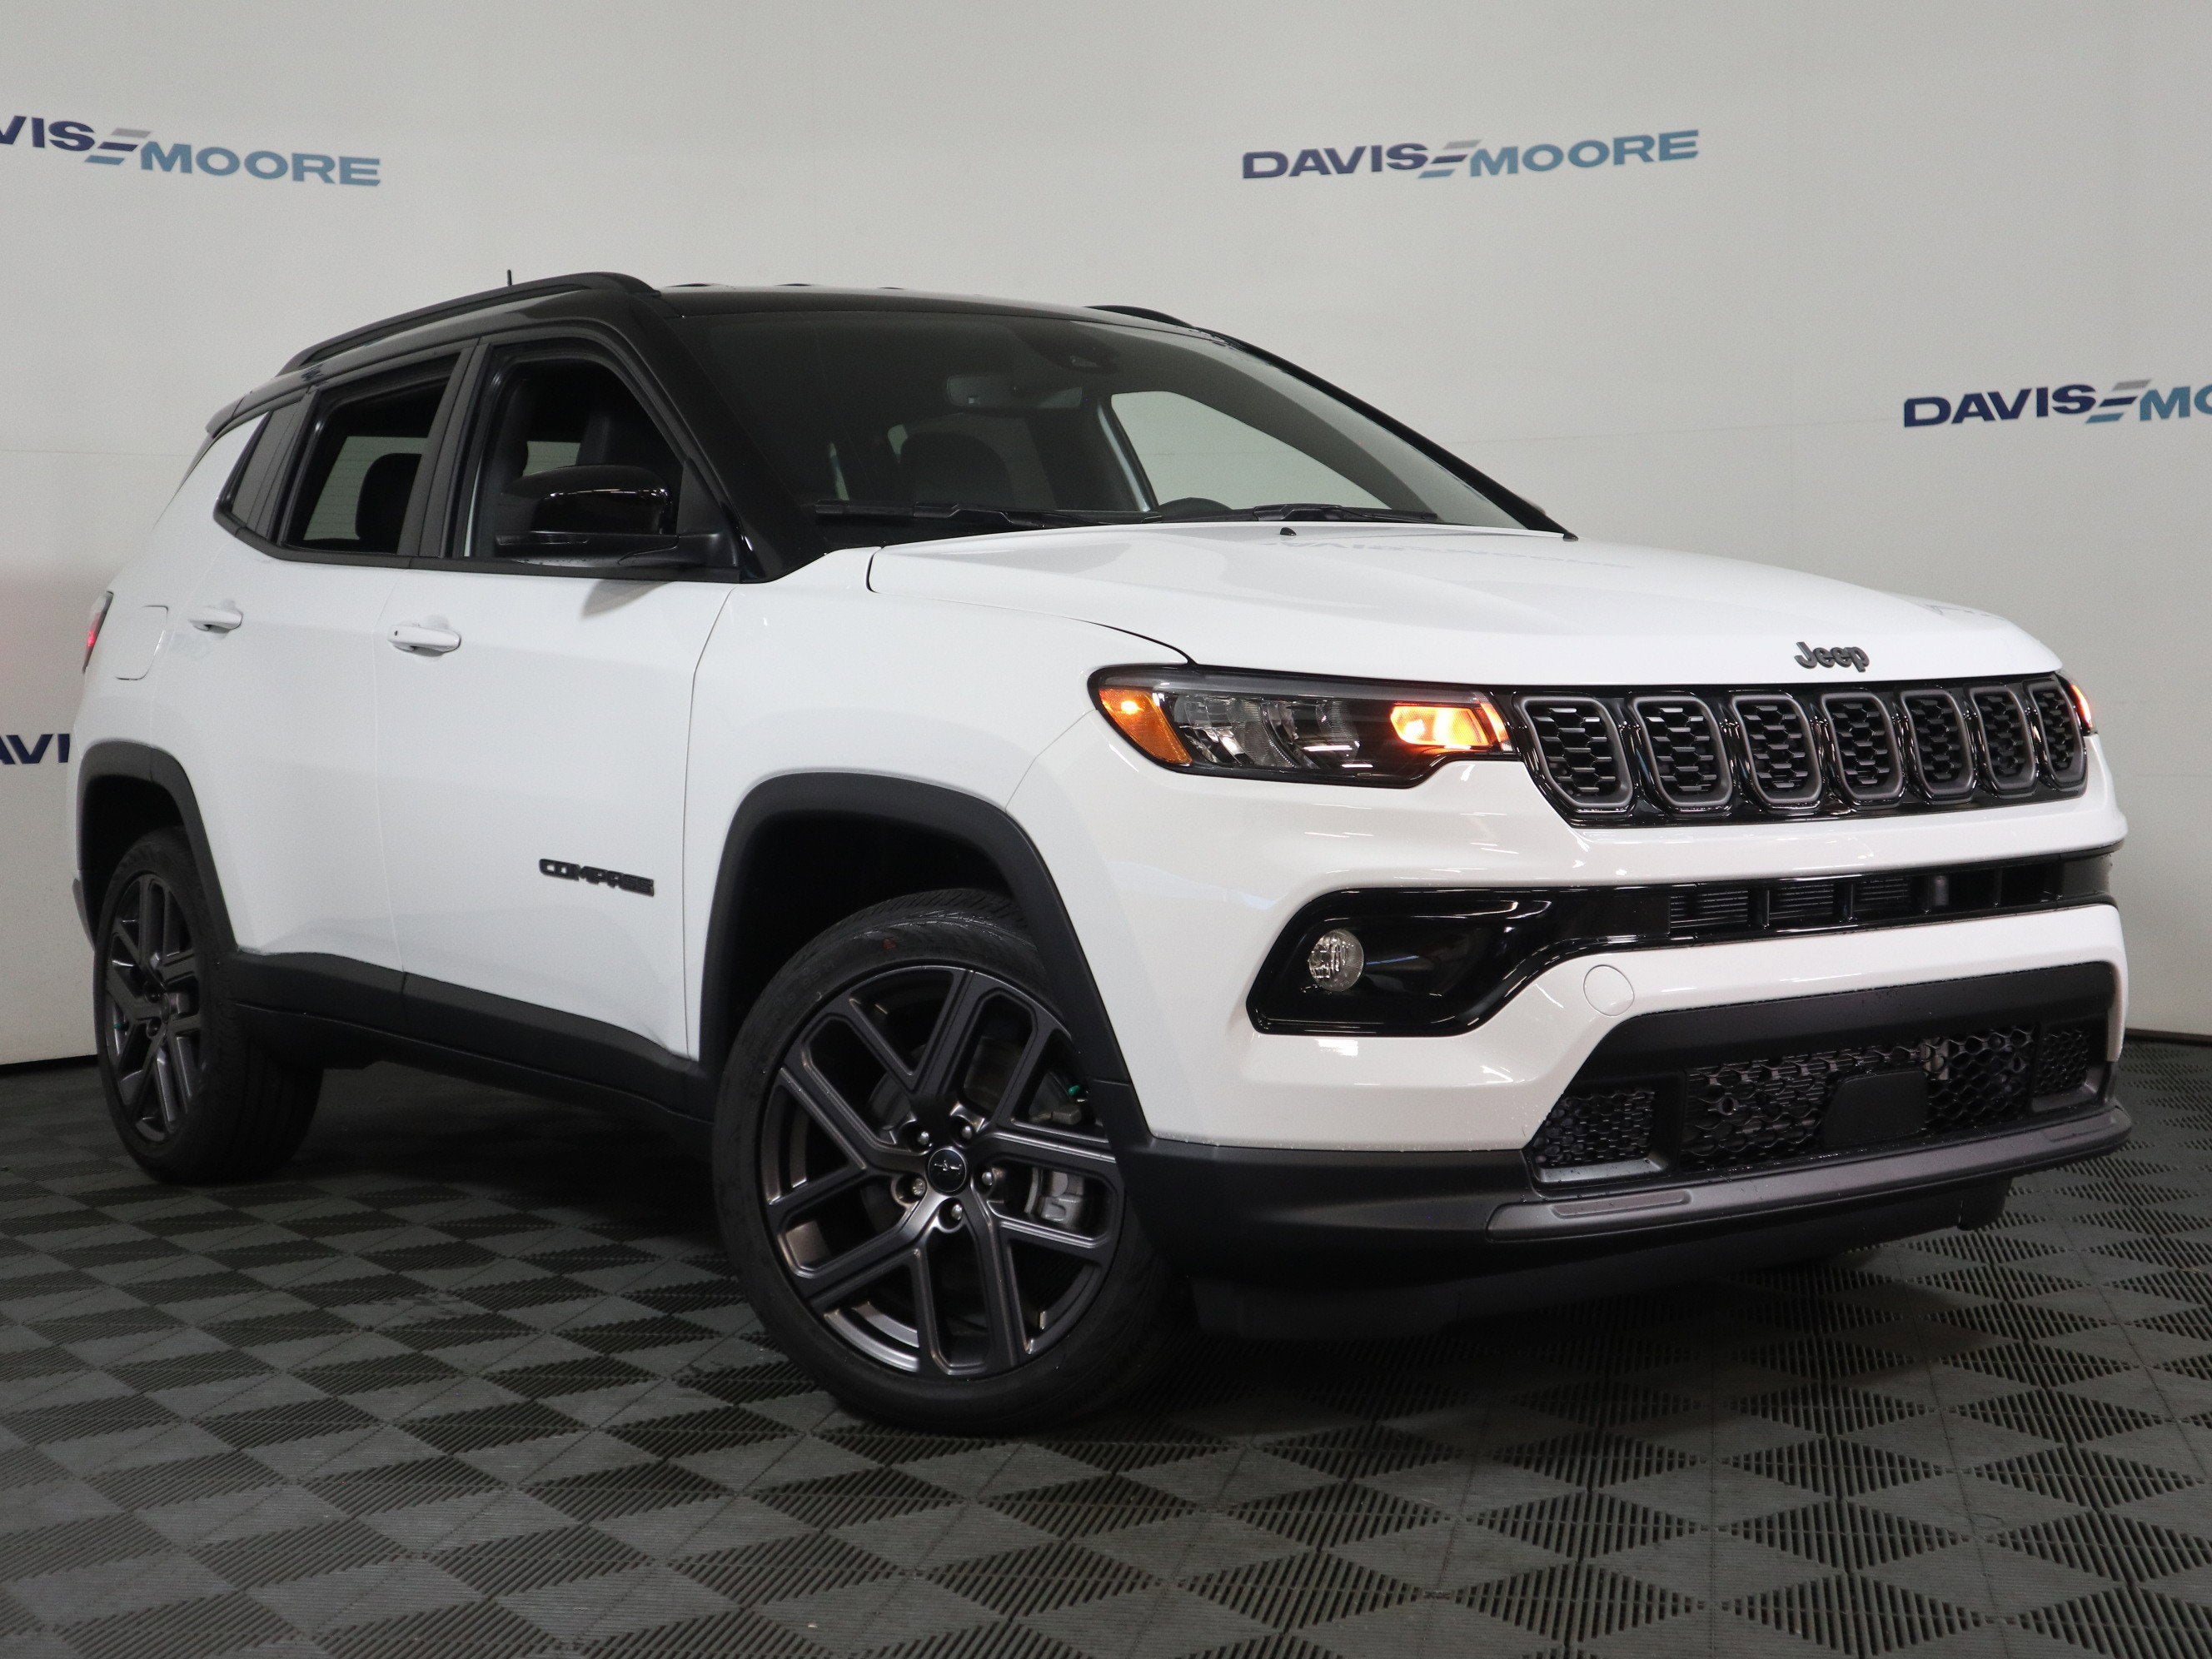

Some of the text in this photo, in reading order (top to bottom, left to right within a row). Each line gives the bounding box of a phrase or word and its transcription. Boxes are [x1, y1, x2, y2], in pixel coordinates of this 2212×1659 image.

[140, 141, 381, 187] MOORE
[1242, 129, 1699, 179] DAVIS MOORE
[1903, 384, 2096, 428] DAVIS
[1794, 641, 1870, 672] Jeep
[539, 858, 655, 897] COMPASS
